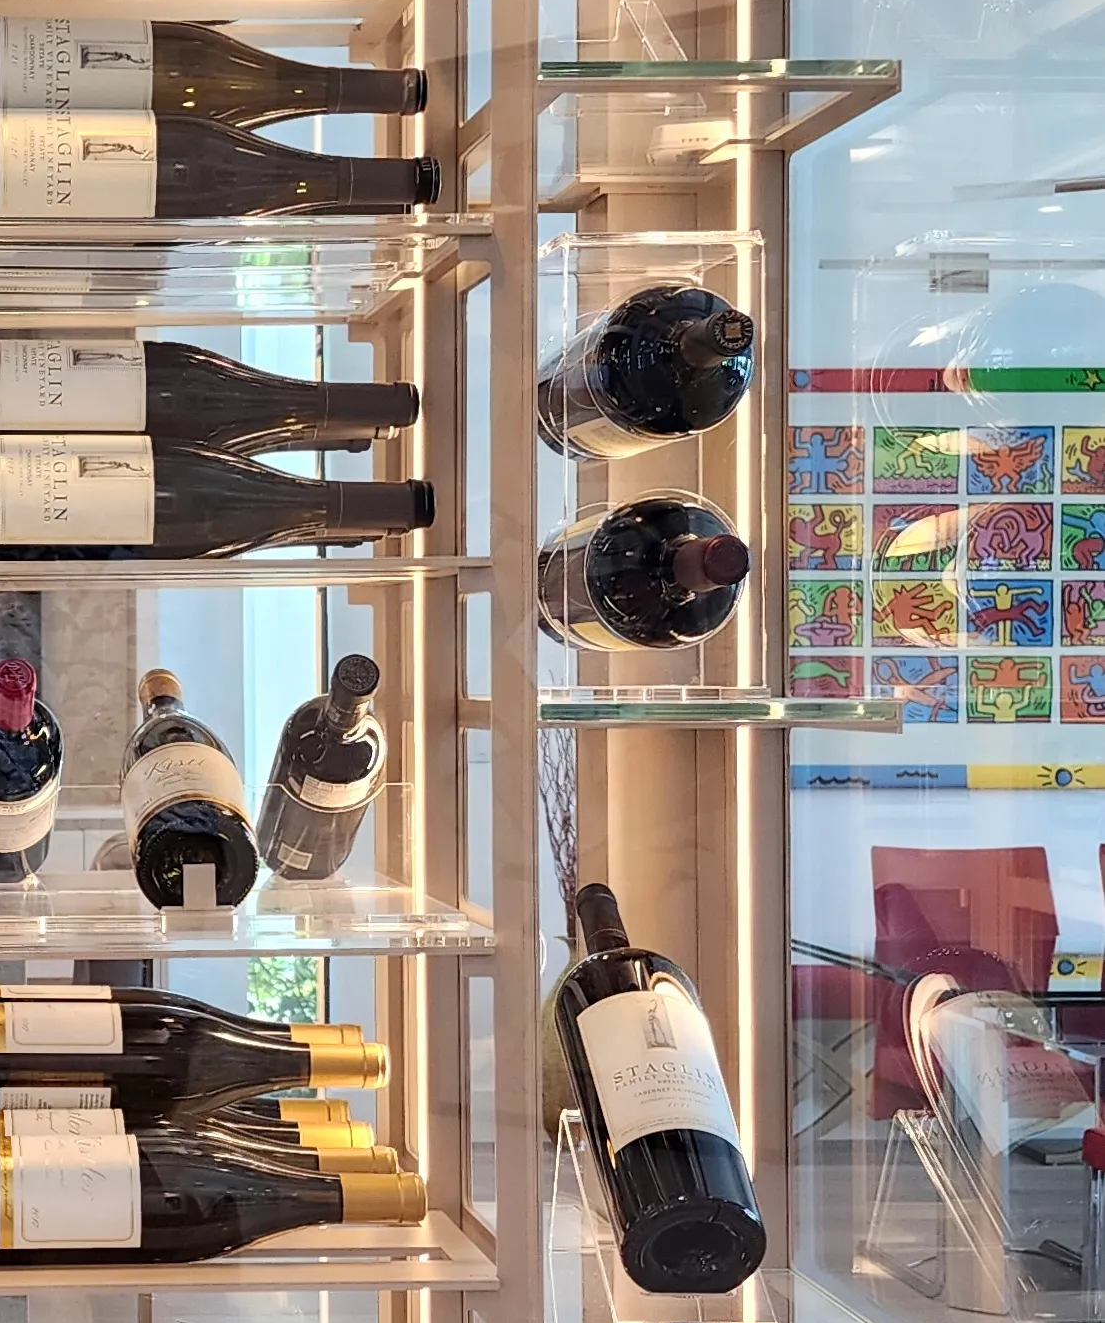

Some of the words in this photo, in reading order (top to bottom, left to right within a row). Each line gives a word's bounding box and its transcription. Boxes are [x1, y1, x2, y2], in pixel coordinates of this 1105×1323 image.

[45, 143, 54, 205] VINEYARD
[47, 340, 62, 407] AGLIN
[613, 1062, 716, 1088] STAGLIN
